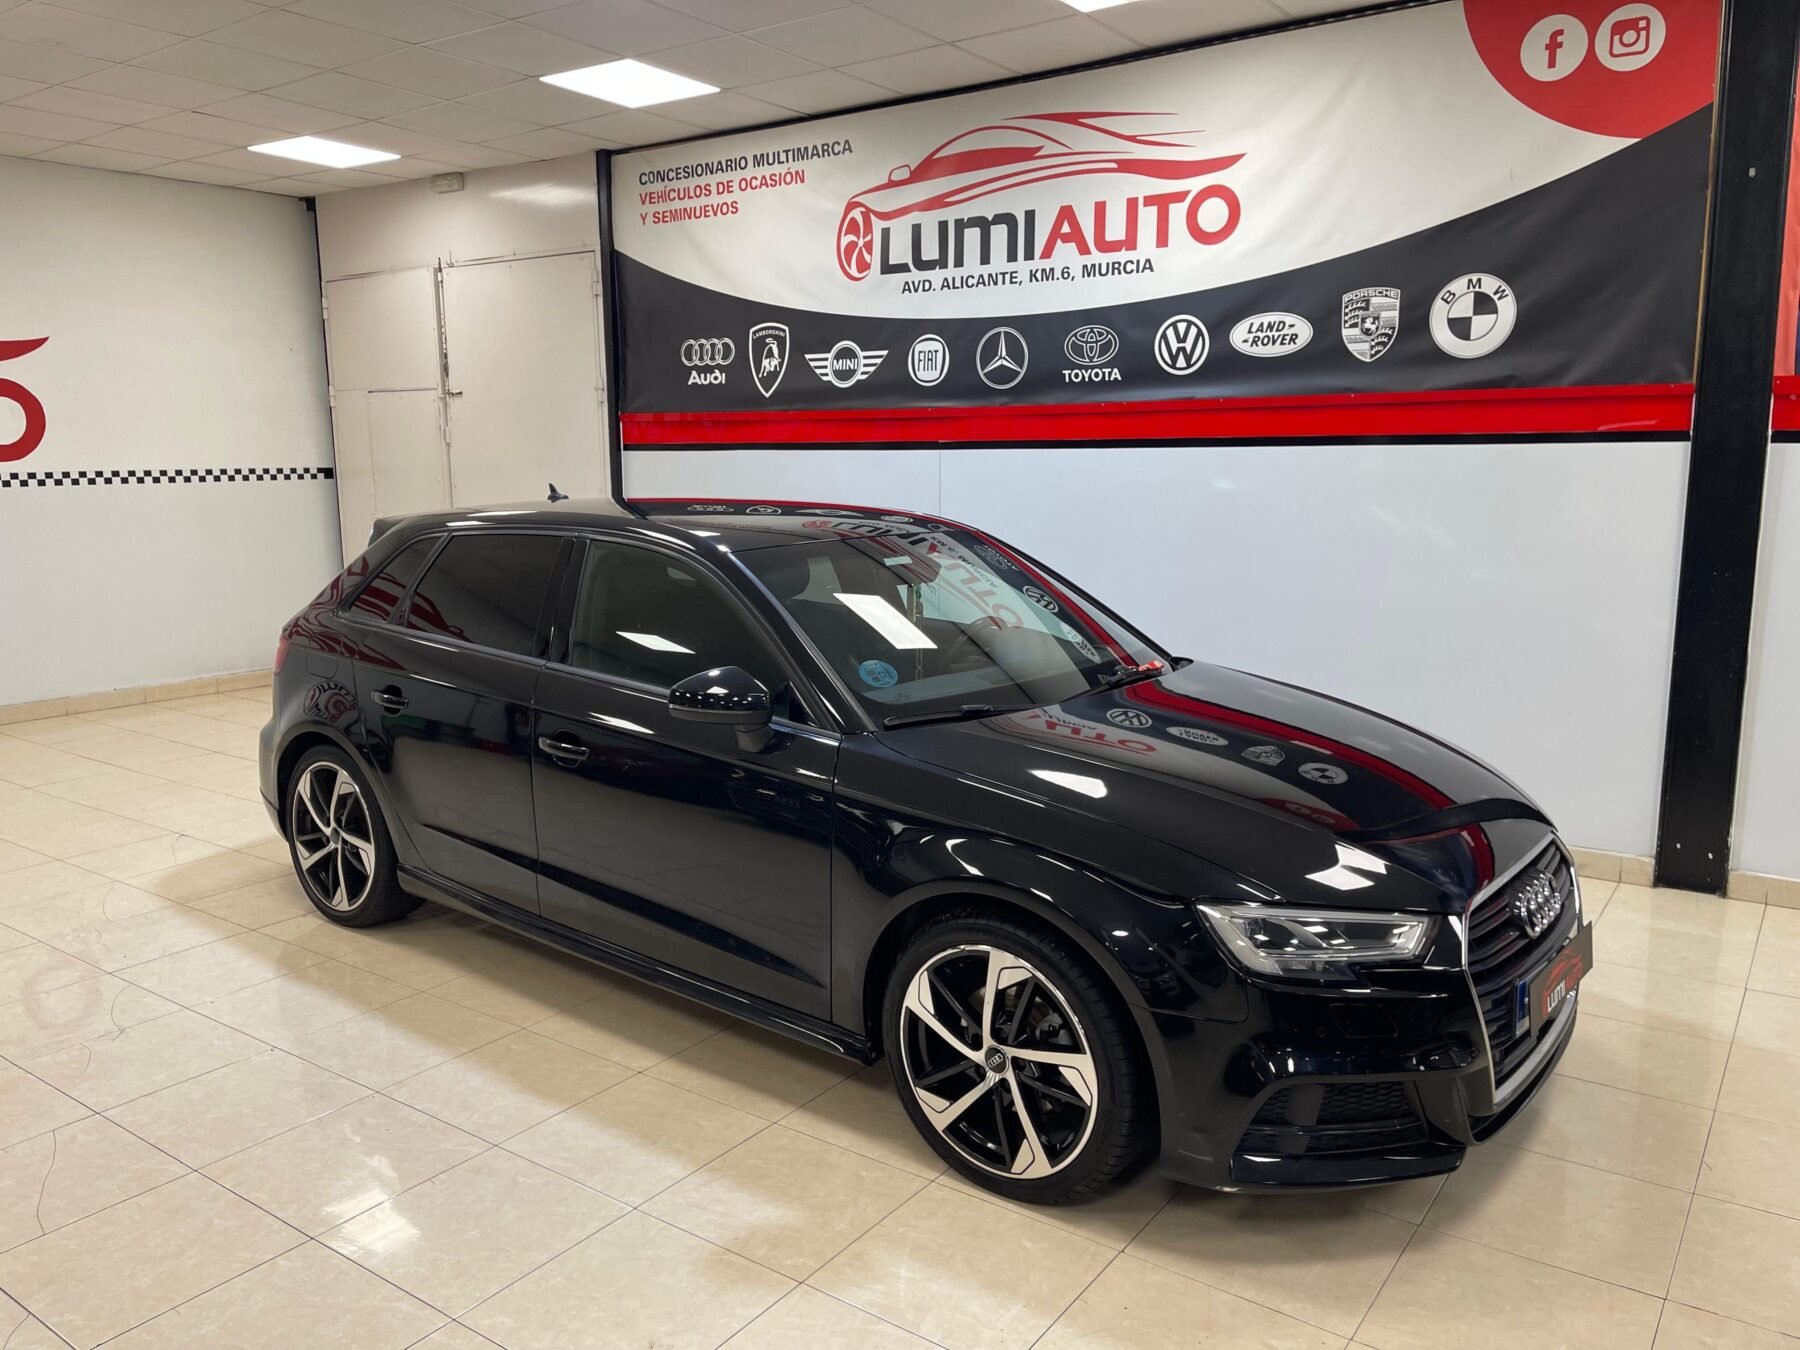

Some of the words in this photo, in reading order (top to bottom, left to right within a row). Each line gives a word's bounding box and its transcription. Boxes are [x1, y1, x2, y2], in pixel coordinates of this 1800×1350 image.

[639, 156, 748, 186] CONCESIONARIO
[753, 139, 853, 168] MULTIMARCA
[639, 183, 712, 206] VEHÍCULOS
[716, 180, 734, 196] DE
[738, 168, 806, 192] OCASIÓN
[640, 212, 648, 225] Y
[652, 200, 739, 225] SEMINUEVOS
[901, 276, 937, 295] AVD.
[940, 270, 1024, 291] ALICANTE,
[1029, 264, 1076, 284] KM.6,
[1081, 257, 1155, 279] MURCIA
[1344, 288, 1399, 303] PORSCHE
[1441, 277, 1509, 305] BMW
[752, 328, 786, 340] LAMBORGHINI
[1247, 320, 1287, 335] LAND
[1249, 332, 1299, 347] ROVER
[832, 357, 858, 371] MINI
[917, 348, 940, 373] FIAT
[687, 369, 726, 385] Audi
[1062, 367, 1122, 383] TOYOTA
